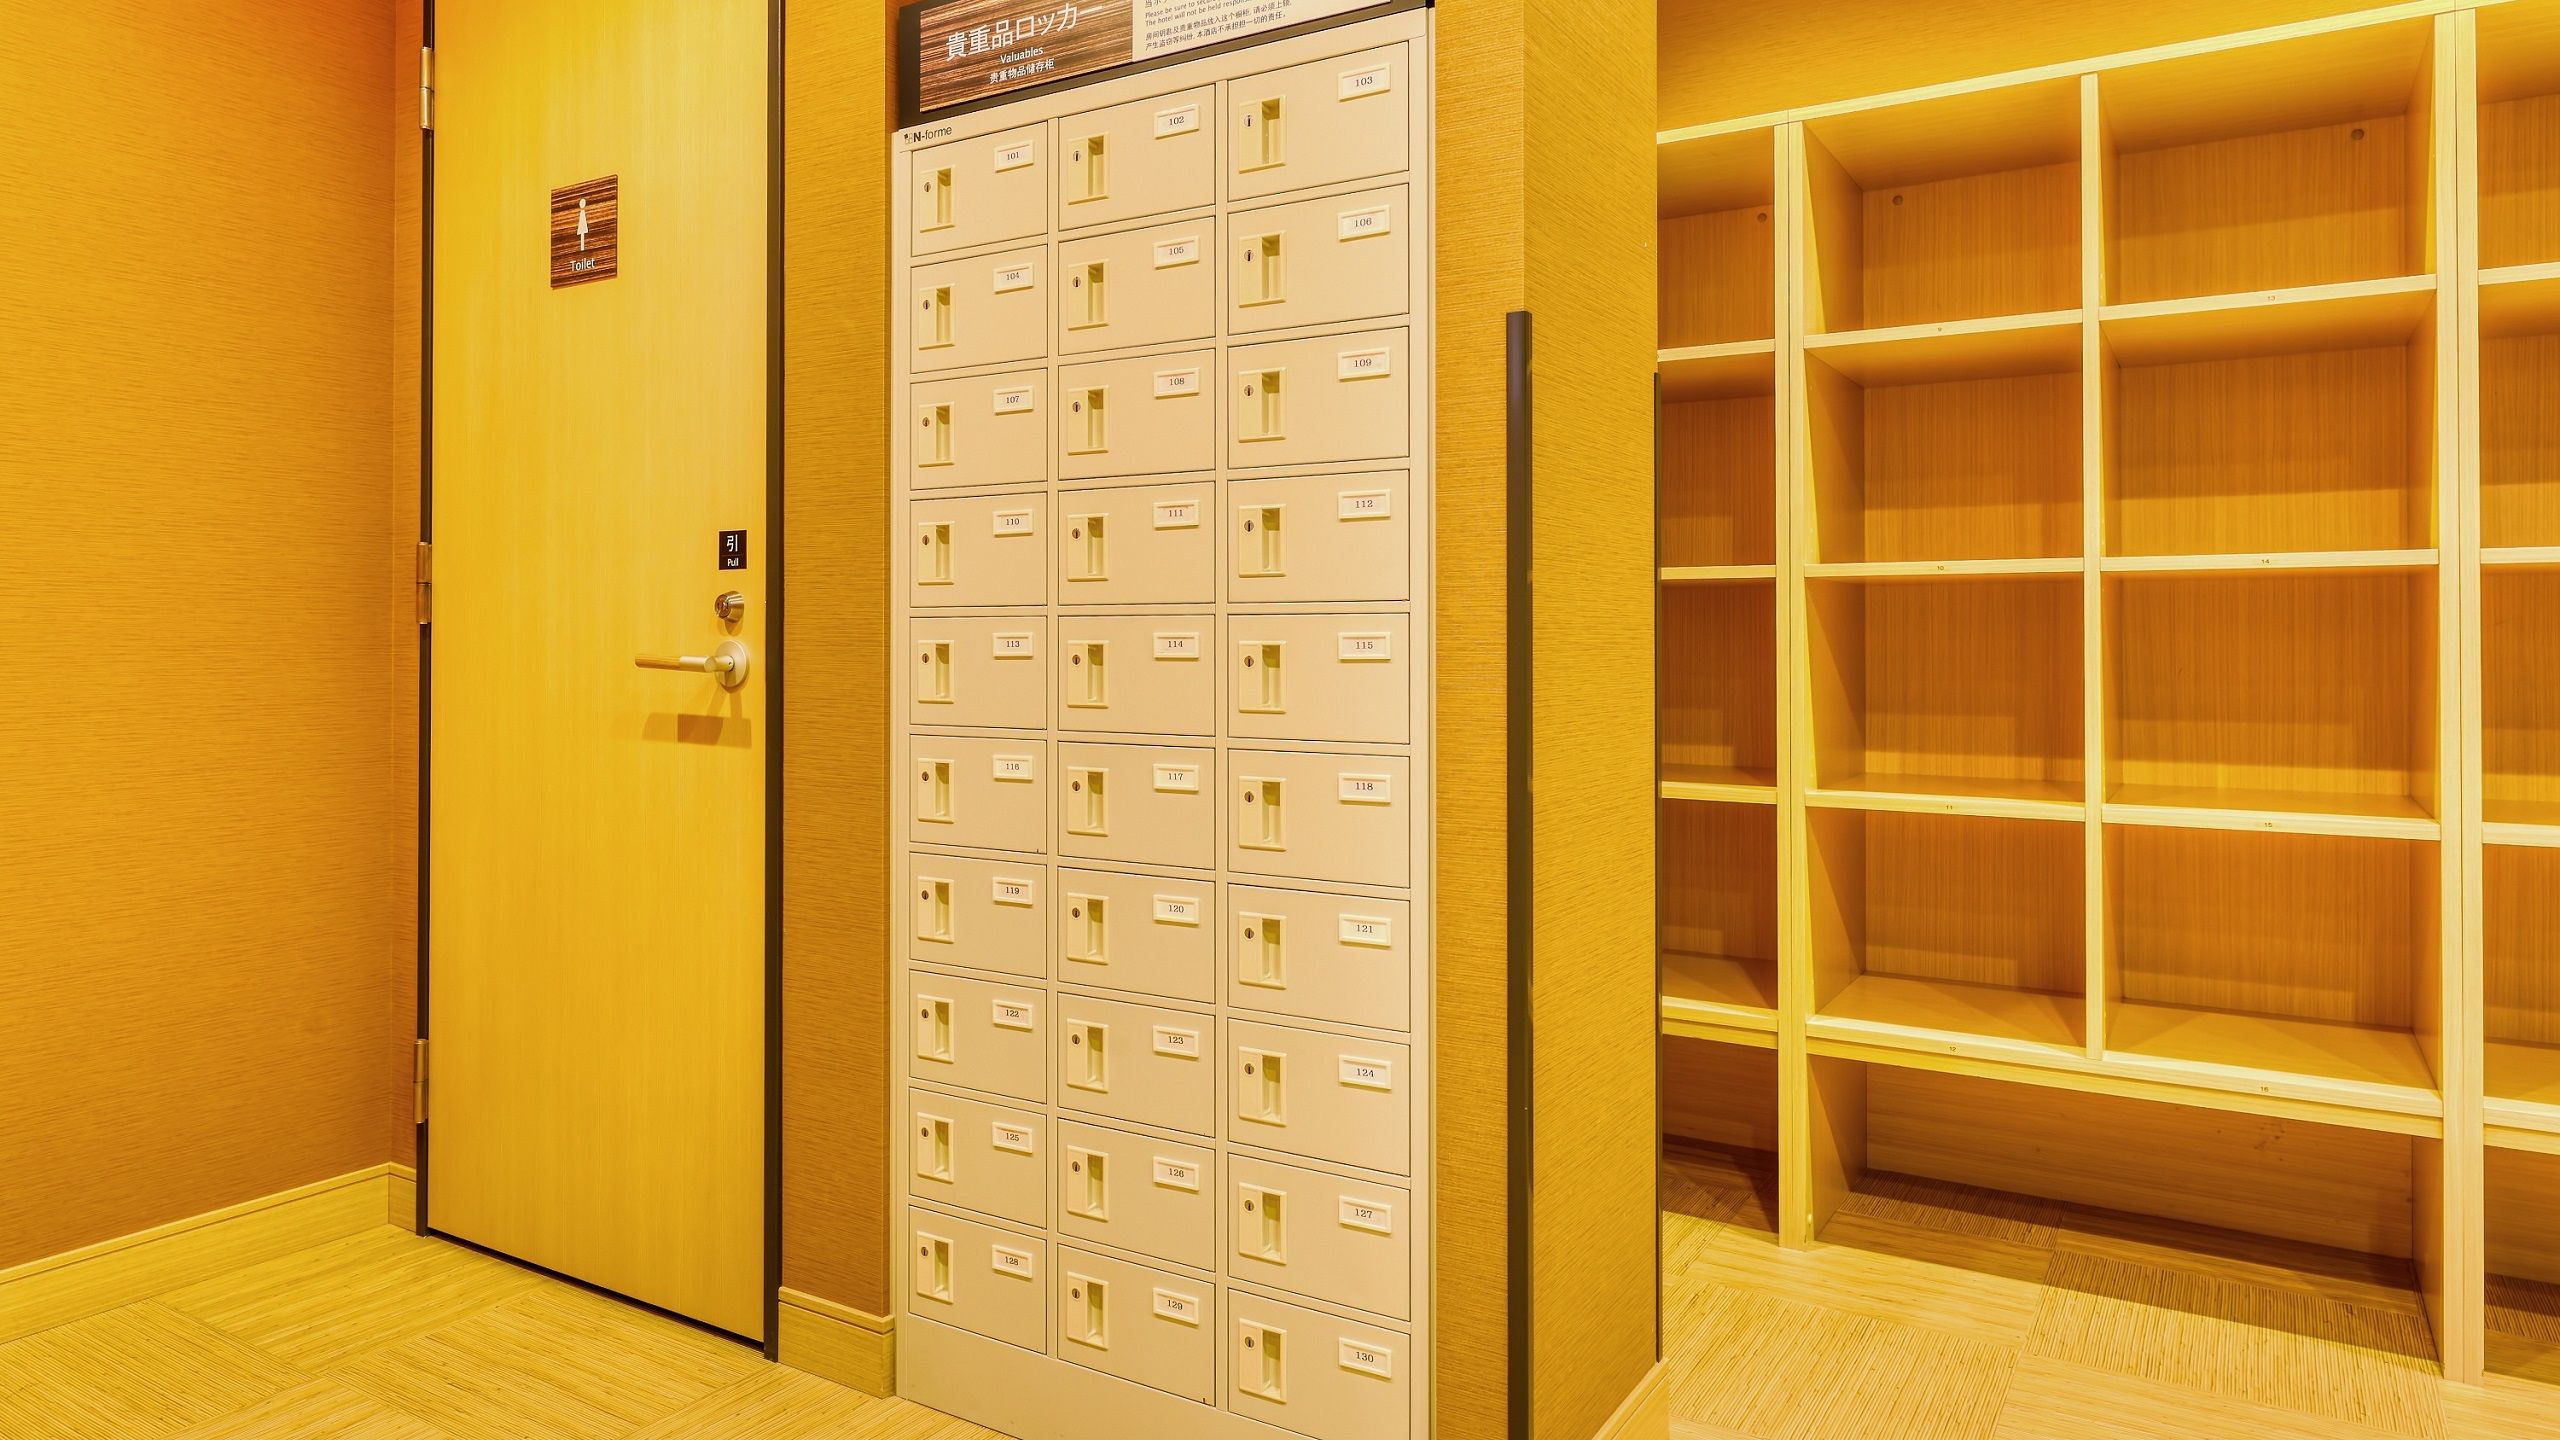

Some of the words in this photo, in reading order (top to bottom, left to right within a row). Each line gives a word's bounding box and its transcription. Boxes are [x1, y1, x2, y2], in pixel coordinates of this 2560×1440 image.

[1145, 10, 1163, 18] Please
[1158, 14, 1173, 23] hotel
[1175, 11, 1186, 19] will
[1187, 9, 1197, 17] not
[1199, 6, 1206, 14] be
[1208, 3, 1222, 11] held
[946, 3, 1103, 61] 貴重品ロッカー
[1000, 46, 1043, 64] Valuables
[990, 58, 1055, 84] 贵重物品储存柜
[1357, 76, 1372, 87] 103
[1169, 115, 1184, 126] 102
[913, 126, 952, 143] N-forme
[1007, 152, 1019, 161] 101
[1356, 217, 1372, 228] 106
[1170, 246, 1184, 255] 105
[570, 257, 595, 272] Toilet
[1006, 272, 1020, 281] 104
[1355, 358, 1372, 368] 109
[1170, 377, 1184, 386] 108
[1007, 395, 1020, 404] 107
[1356, 499, 1373, 508] 112
[1169, 510, 1183, 518] 111
[1007, 518, 1020, 526] 110
[727, 535, 738, 552] 引
[727, 558, 739, 567] Pull
[1007, 640, 1020, 648] 113
[1169, 640, 1183, 648] 114
[1357, 641, 1374, 650] 115
[1006, 763, 1020, 771] 116
[1169, 772, 1184, 781] 117
[1357, 782, 1374, 791] 118
[1006, 886, 1020, 895] 119
[1169, 904, 1184, 913] 120
[1357, 924, 1373, 933] 121
[1005, 1009, 1019, 1018] 122
[1168, 1035, 1184, 1045] 123
[1357, 1068, 1374, 1078] 124
[1005, 1132, 1020, 1142] 125
[1169, 1168, 1185, 1178] 126
[1356, 1208, 1373, 1219] 127
[1005, 1256, 1019, 1266] 128
[1168, 1299, 1183, 1311] 129
[1357, 1351, 1374, 1363] 130
